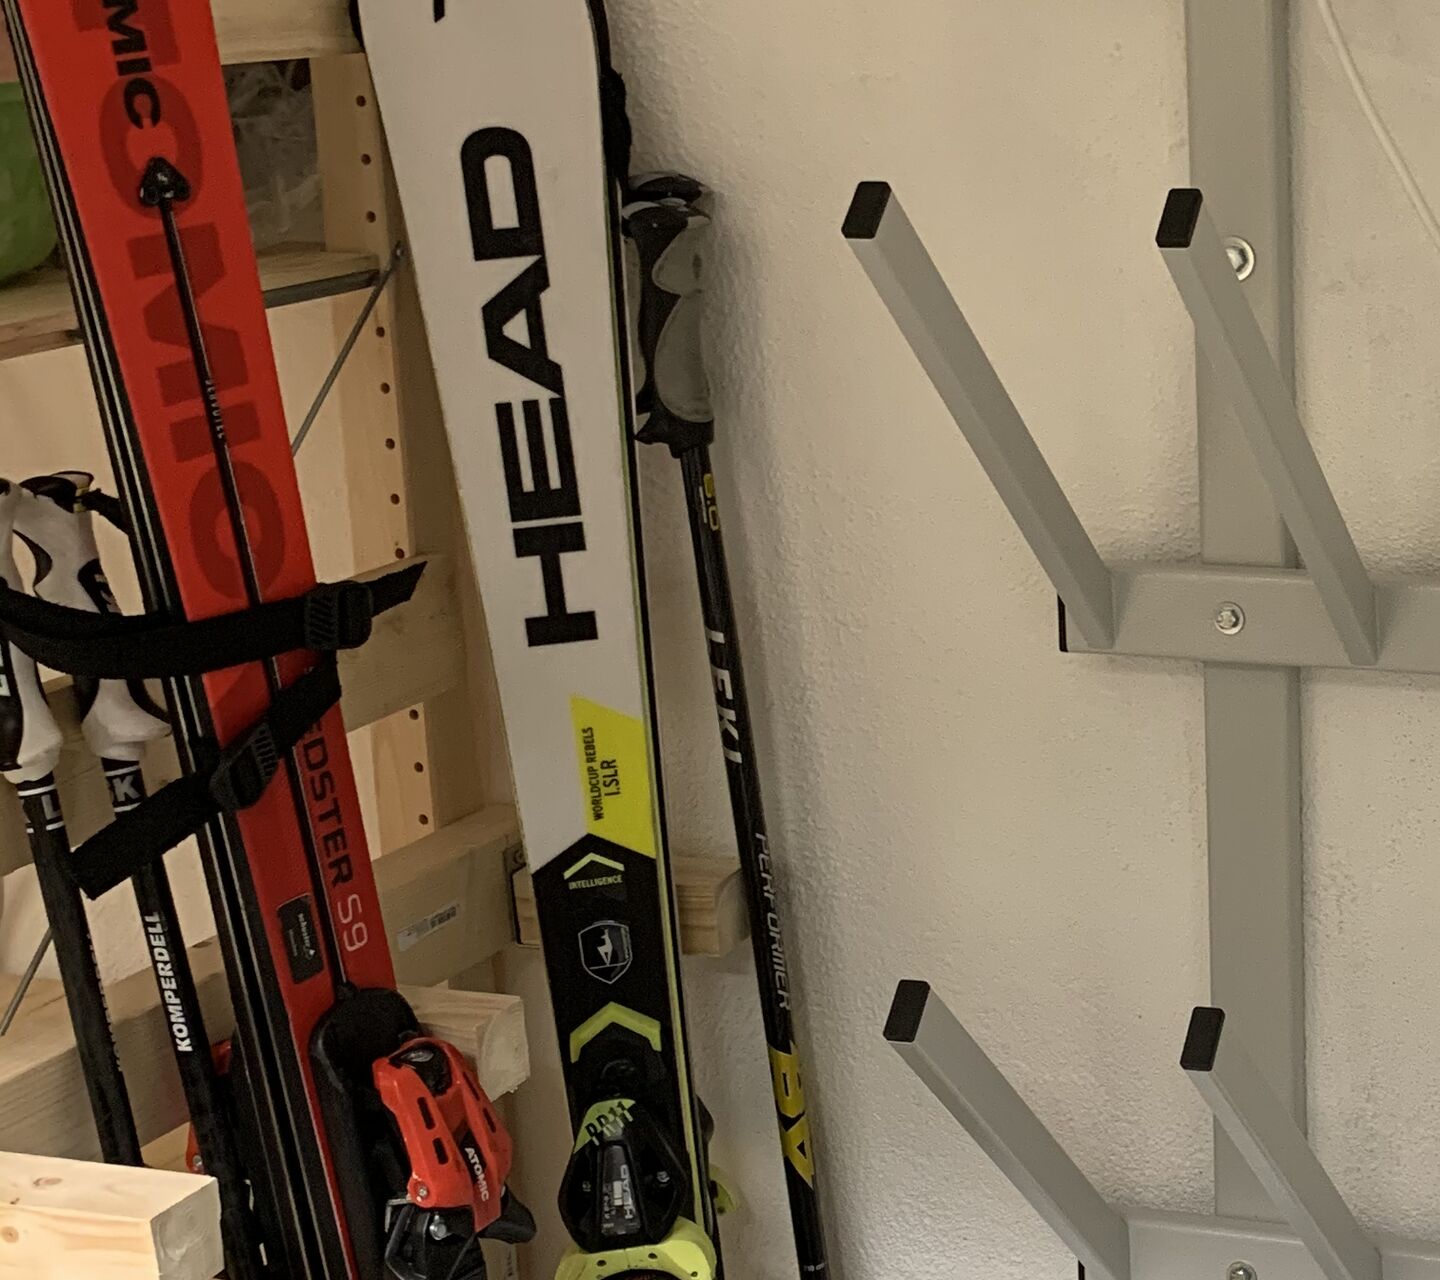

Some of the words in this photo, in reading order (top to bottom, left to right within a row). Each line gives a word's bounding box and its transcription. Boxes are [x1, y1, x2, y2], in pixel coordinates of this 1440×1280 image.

[460, 126, 599, 647] HEAD
[581, 727, 597, 763] REBELS
[586, 766, 604, 821] WORLDCUP
[600, 759, 621, 797] I.SLR
[303, 721, 354, 890] DSTER
[337, 893, 368, 953] S9
[568, 874, 623, 891] INTELLIGENCE
[755, 832, 792, 1012] PERFORMER
[143, 911, 194, 1053] KOMPERDELL
[464, 1147, 489, 1202] ATOMIC
[620, 1164, 634, 1220] HEAD
